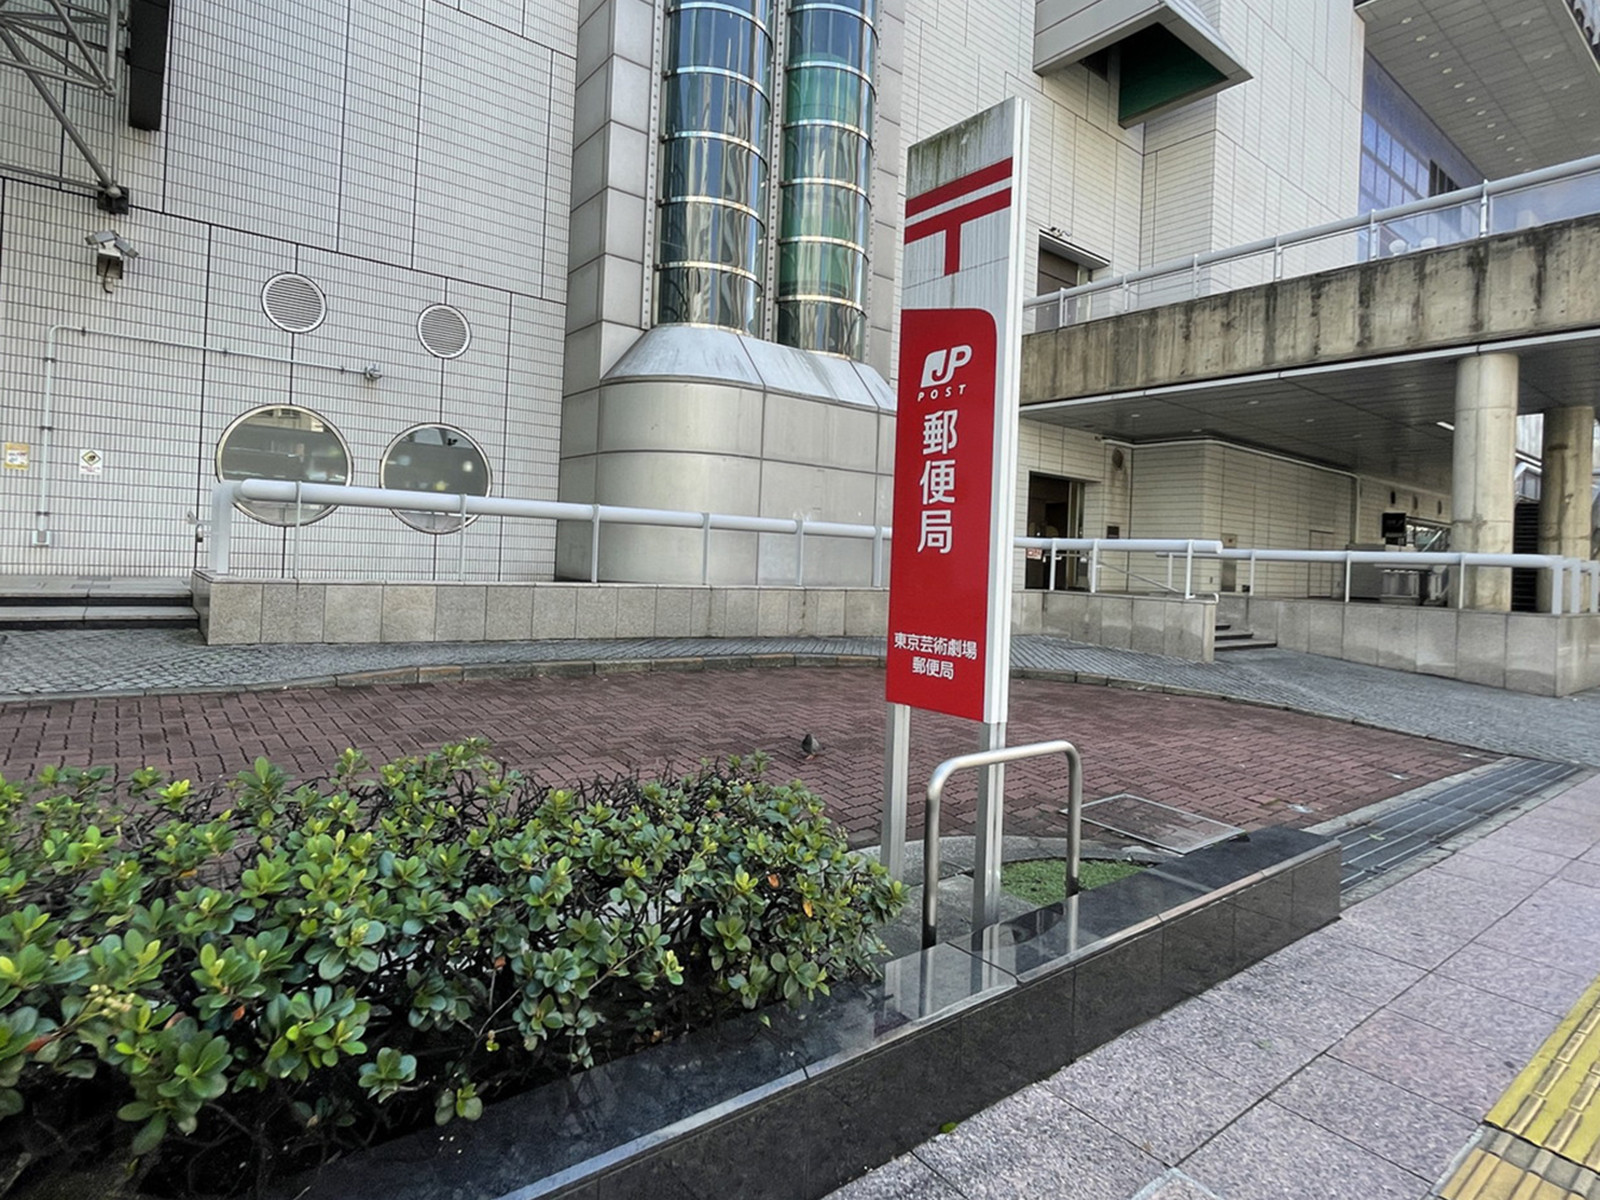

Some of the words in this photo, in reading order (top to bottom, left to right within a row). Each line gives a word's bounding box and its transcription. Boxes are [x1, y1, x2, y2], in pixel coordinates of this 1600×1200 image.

[920, 345, 972, 388] JP
[917, 384, 967, 402] POST
[917, 409, 959, 554] 郵便局
[893, 631, 978, 660] 東京芸術劇場
[912, 656, 954, 680] 郵便局
